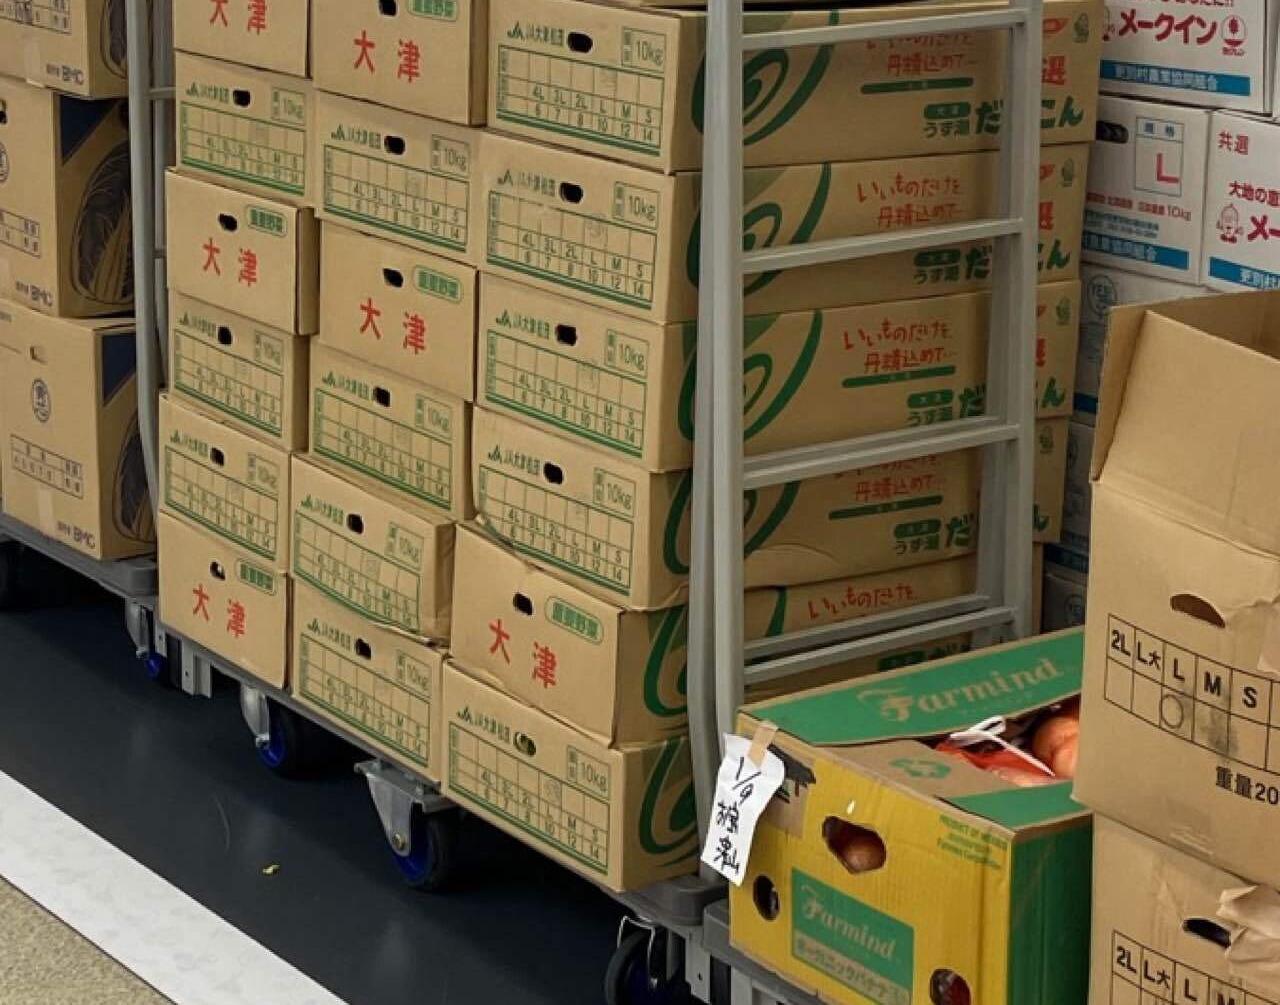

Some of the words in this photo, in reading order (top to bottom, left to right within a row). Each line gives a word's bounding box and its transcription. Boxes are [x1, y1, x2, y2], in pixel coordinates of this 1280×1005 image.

[635, 40, 664, 67] 10kg
[1118, 8, 1218, 46] メークイン
[353, 29, 421, 84] 大津
[1155, 152, 1180, 185] L
[628, 195, 656, 222] 10kg
[201, 236, 258, 287] 大津
[359, 297, 427, 356] 大津
[192, 583, 247, 639] 大津
[489, 618, 558, 689] 大津
[1110, 629, 1131, 657] 2L
[1136, 641, 1162, 670] L大
[1173, 658, 1185, 682] L
[1204, 671, 1221, 696] M
[1243, 686, 1258, 709] S
[859, 657, 1063, 723] Farmind
[580, 759, 608, 786] 10kg
[1116, 946, 1137, 973] 2L
[1143, 958, 1172, 988] L大
[1185, 979, 1198, 1002] L
